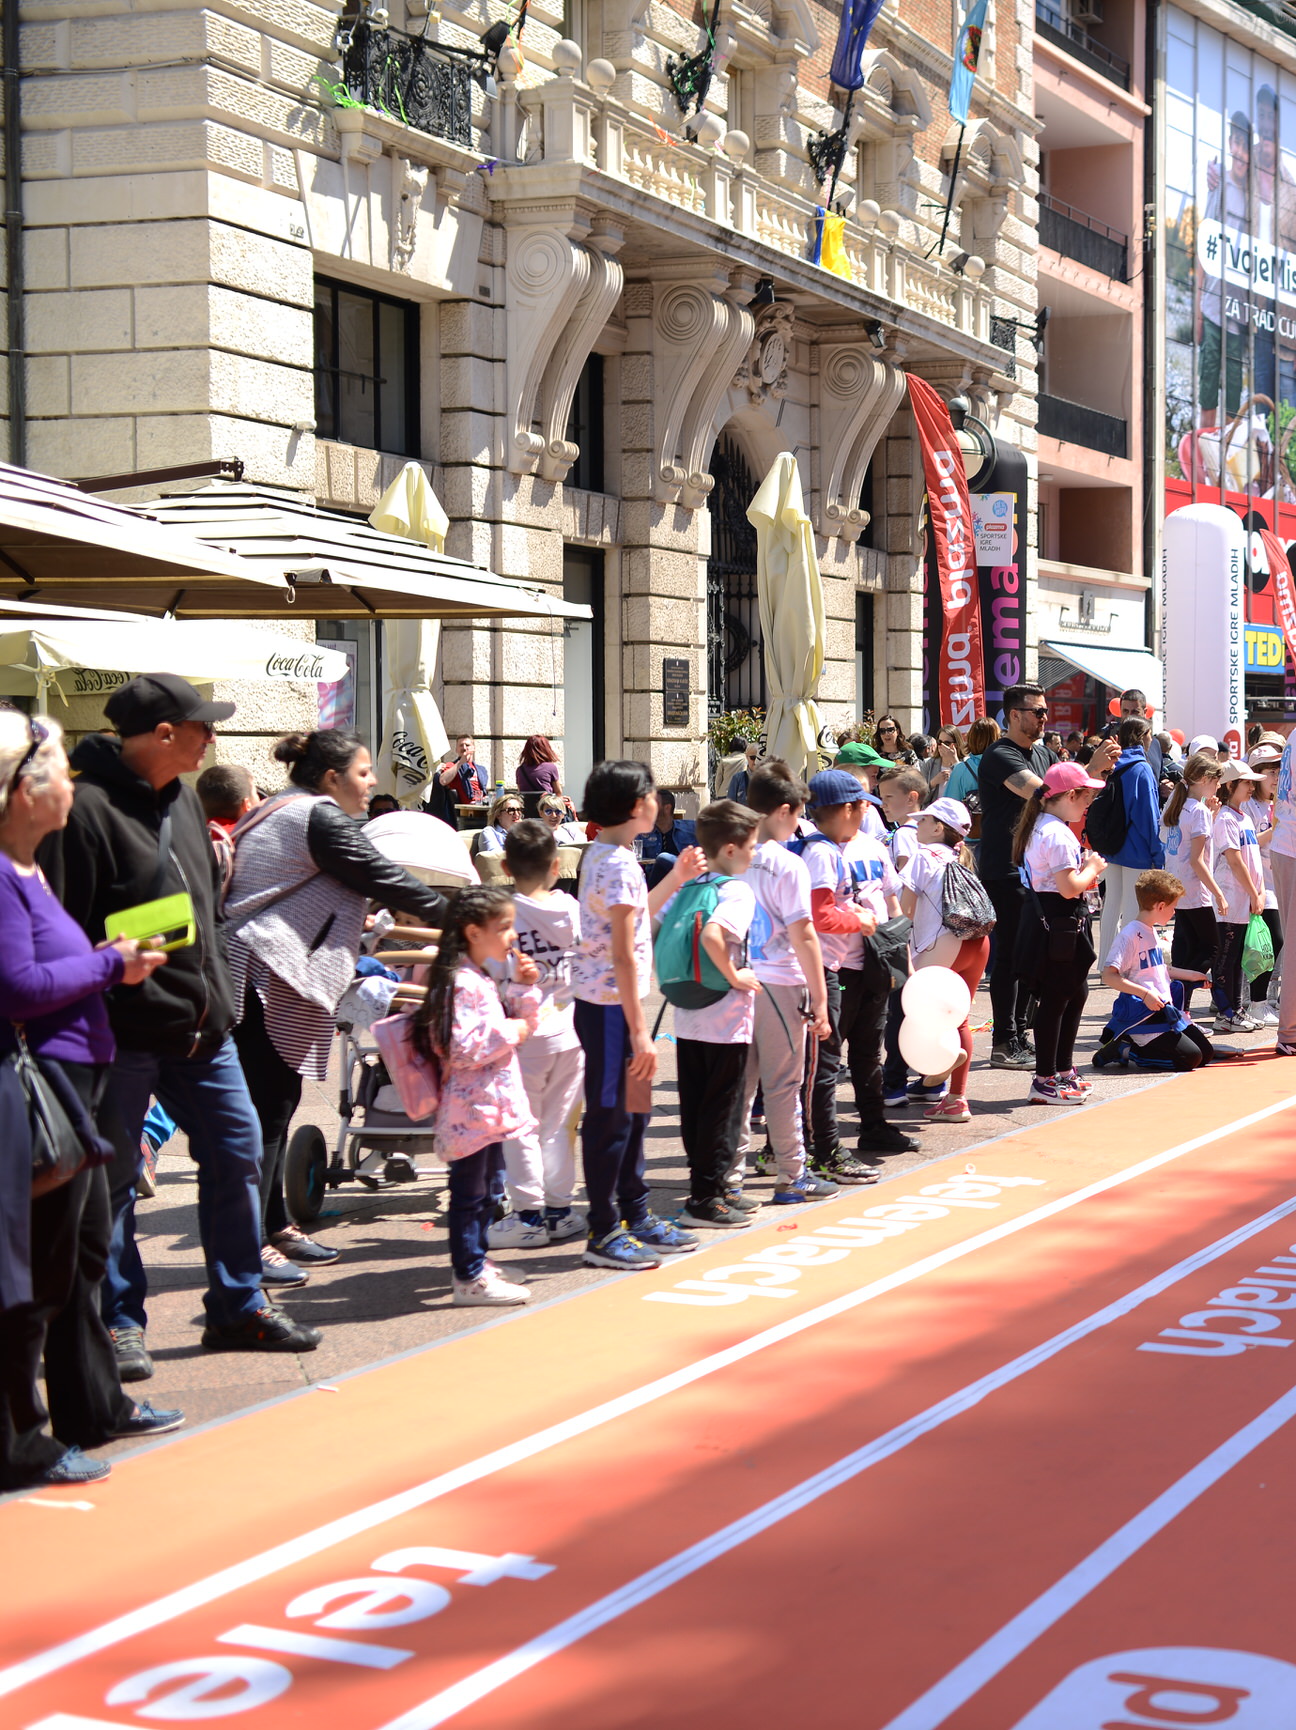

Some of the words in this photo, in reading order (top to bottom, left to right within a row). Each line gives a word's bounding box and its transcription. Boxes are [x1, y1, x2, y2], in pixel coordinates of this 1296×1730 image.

[1230, 548, 1239, 607] MLADIH
[1230, 611, 1239, 645] IGRE
[265, 652, 324, 679] Coca-Cola
[1229, 645, 1239, 724] SPORTSKE
[642, 1174, 1047, 1306] telemach
[14, 1546, 557, 1730] tele
